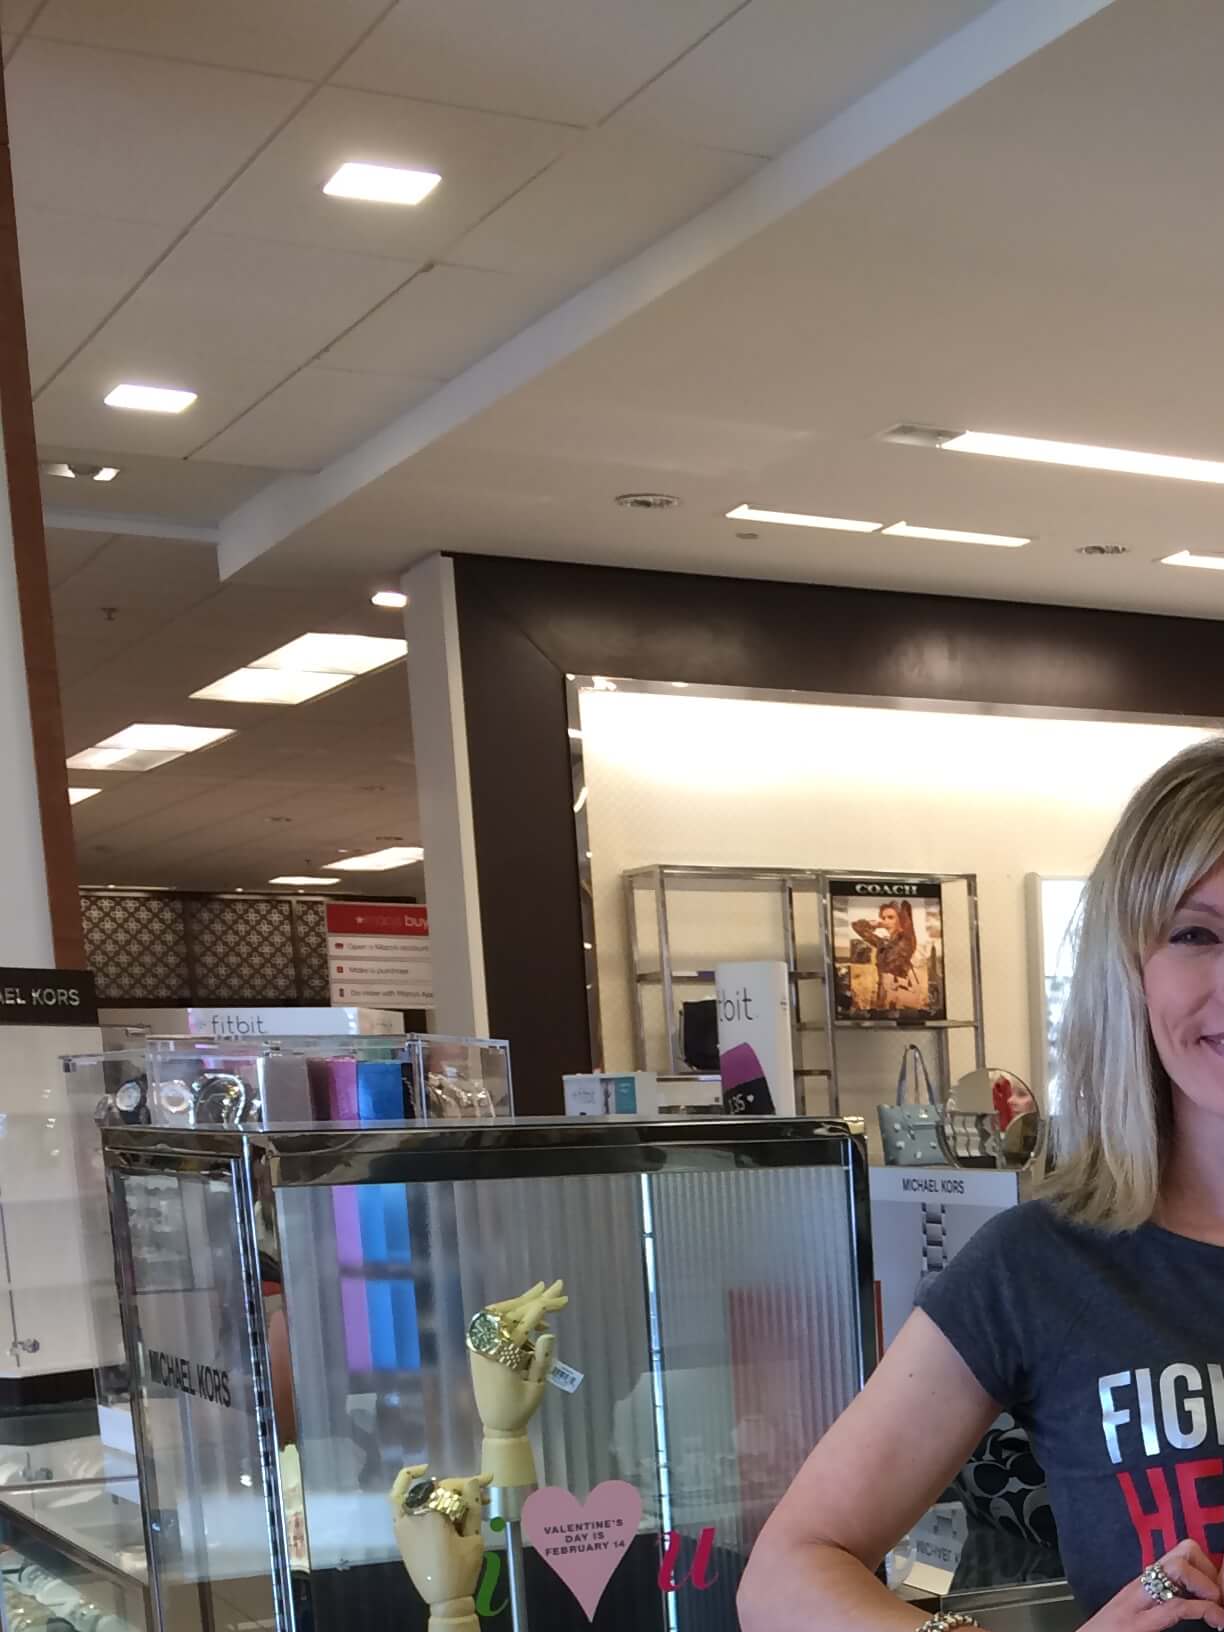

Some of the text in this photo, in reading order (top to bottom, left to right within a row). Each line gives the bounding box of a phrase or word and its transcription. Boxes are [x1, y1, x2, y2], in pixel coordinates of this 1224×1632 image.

[855, 882, 919, 896] COACH
[32, 987, 81, 1006] KORS
[211, 1015, 266, 1034] fitbit
[902, 1178, 965, 1195] MICHAEL KORS
[196, 1363, 232, 1409] KORS
[543, 1518, 624, 1535] VALENTINE'S
[565, 1530, 606, 1544] DAY IS
[545, 1539, 626, 1557] FEBRUARY 14
